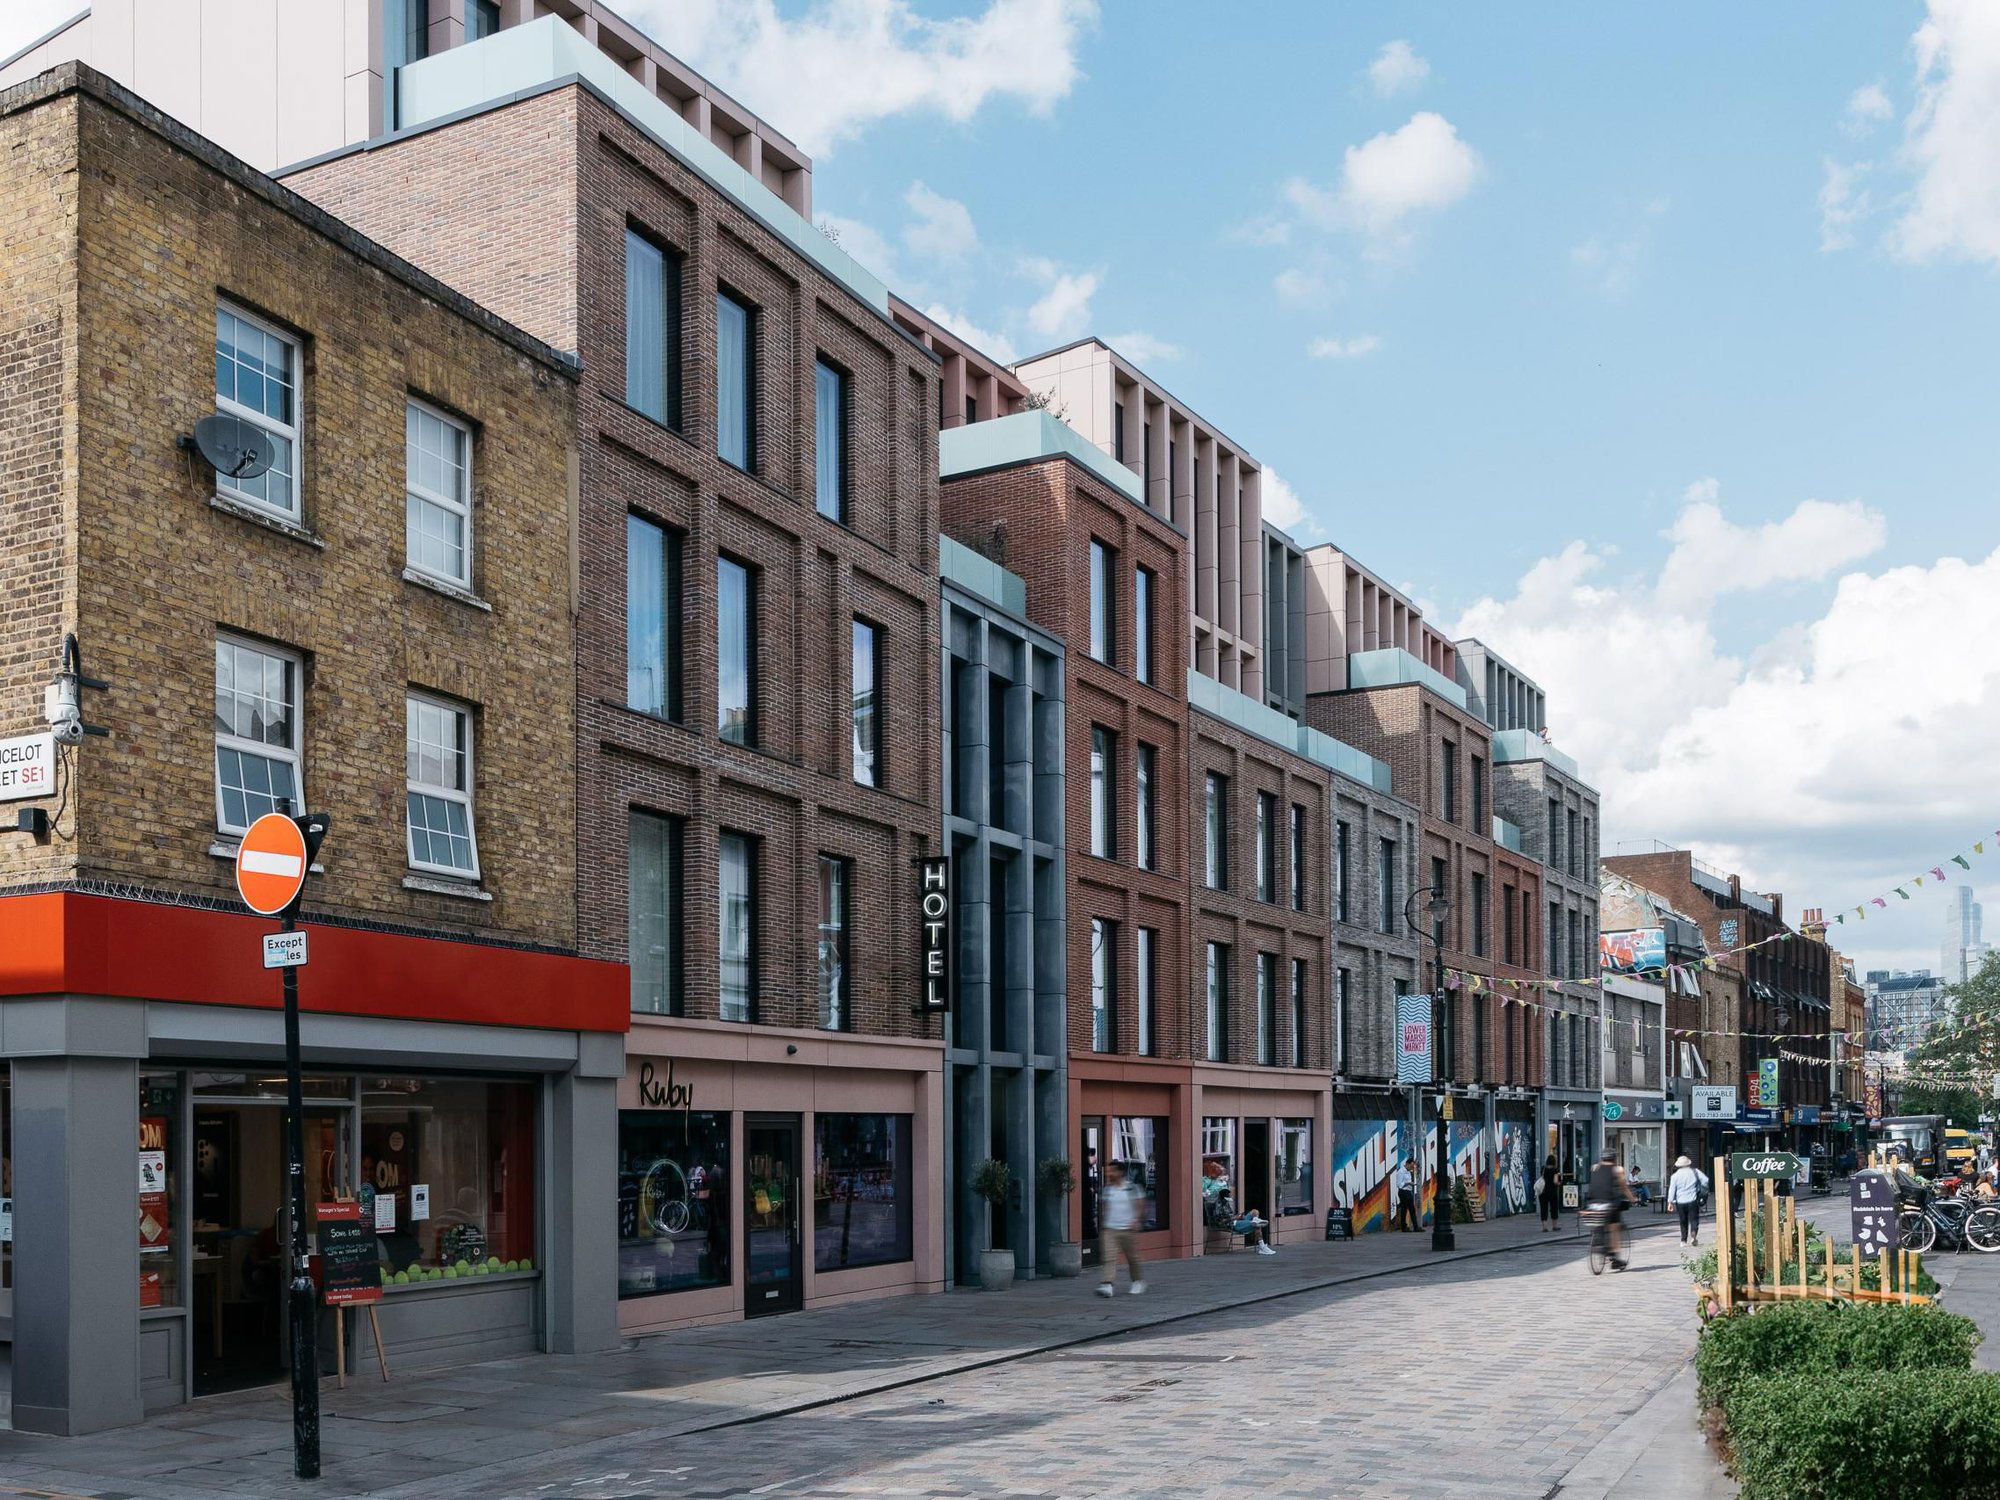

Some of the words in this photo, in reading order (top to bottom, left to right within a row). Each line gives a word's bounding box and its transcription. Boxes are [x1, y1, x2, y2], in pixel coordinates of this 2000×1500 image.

[0, 744, 42, 764] CELOT
[0, 770, 18, 786] ET
[22, 766, 44, 783] SE1
[268, 937, 303, 950] Except
[923, 864, 947, 1005] HOTEL
[1404, 1025, 1426, 1034] LOWER
[1404, 1034, 1426, 1042] MARSH
[1404, 1042, 1426, 1052] MARKET
[640, 1059, 693, 1146] Ruby
[1333, 1120, 1398, 1210] SMILE
[1742, 1157, 1786, 1174] Coffee
